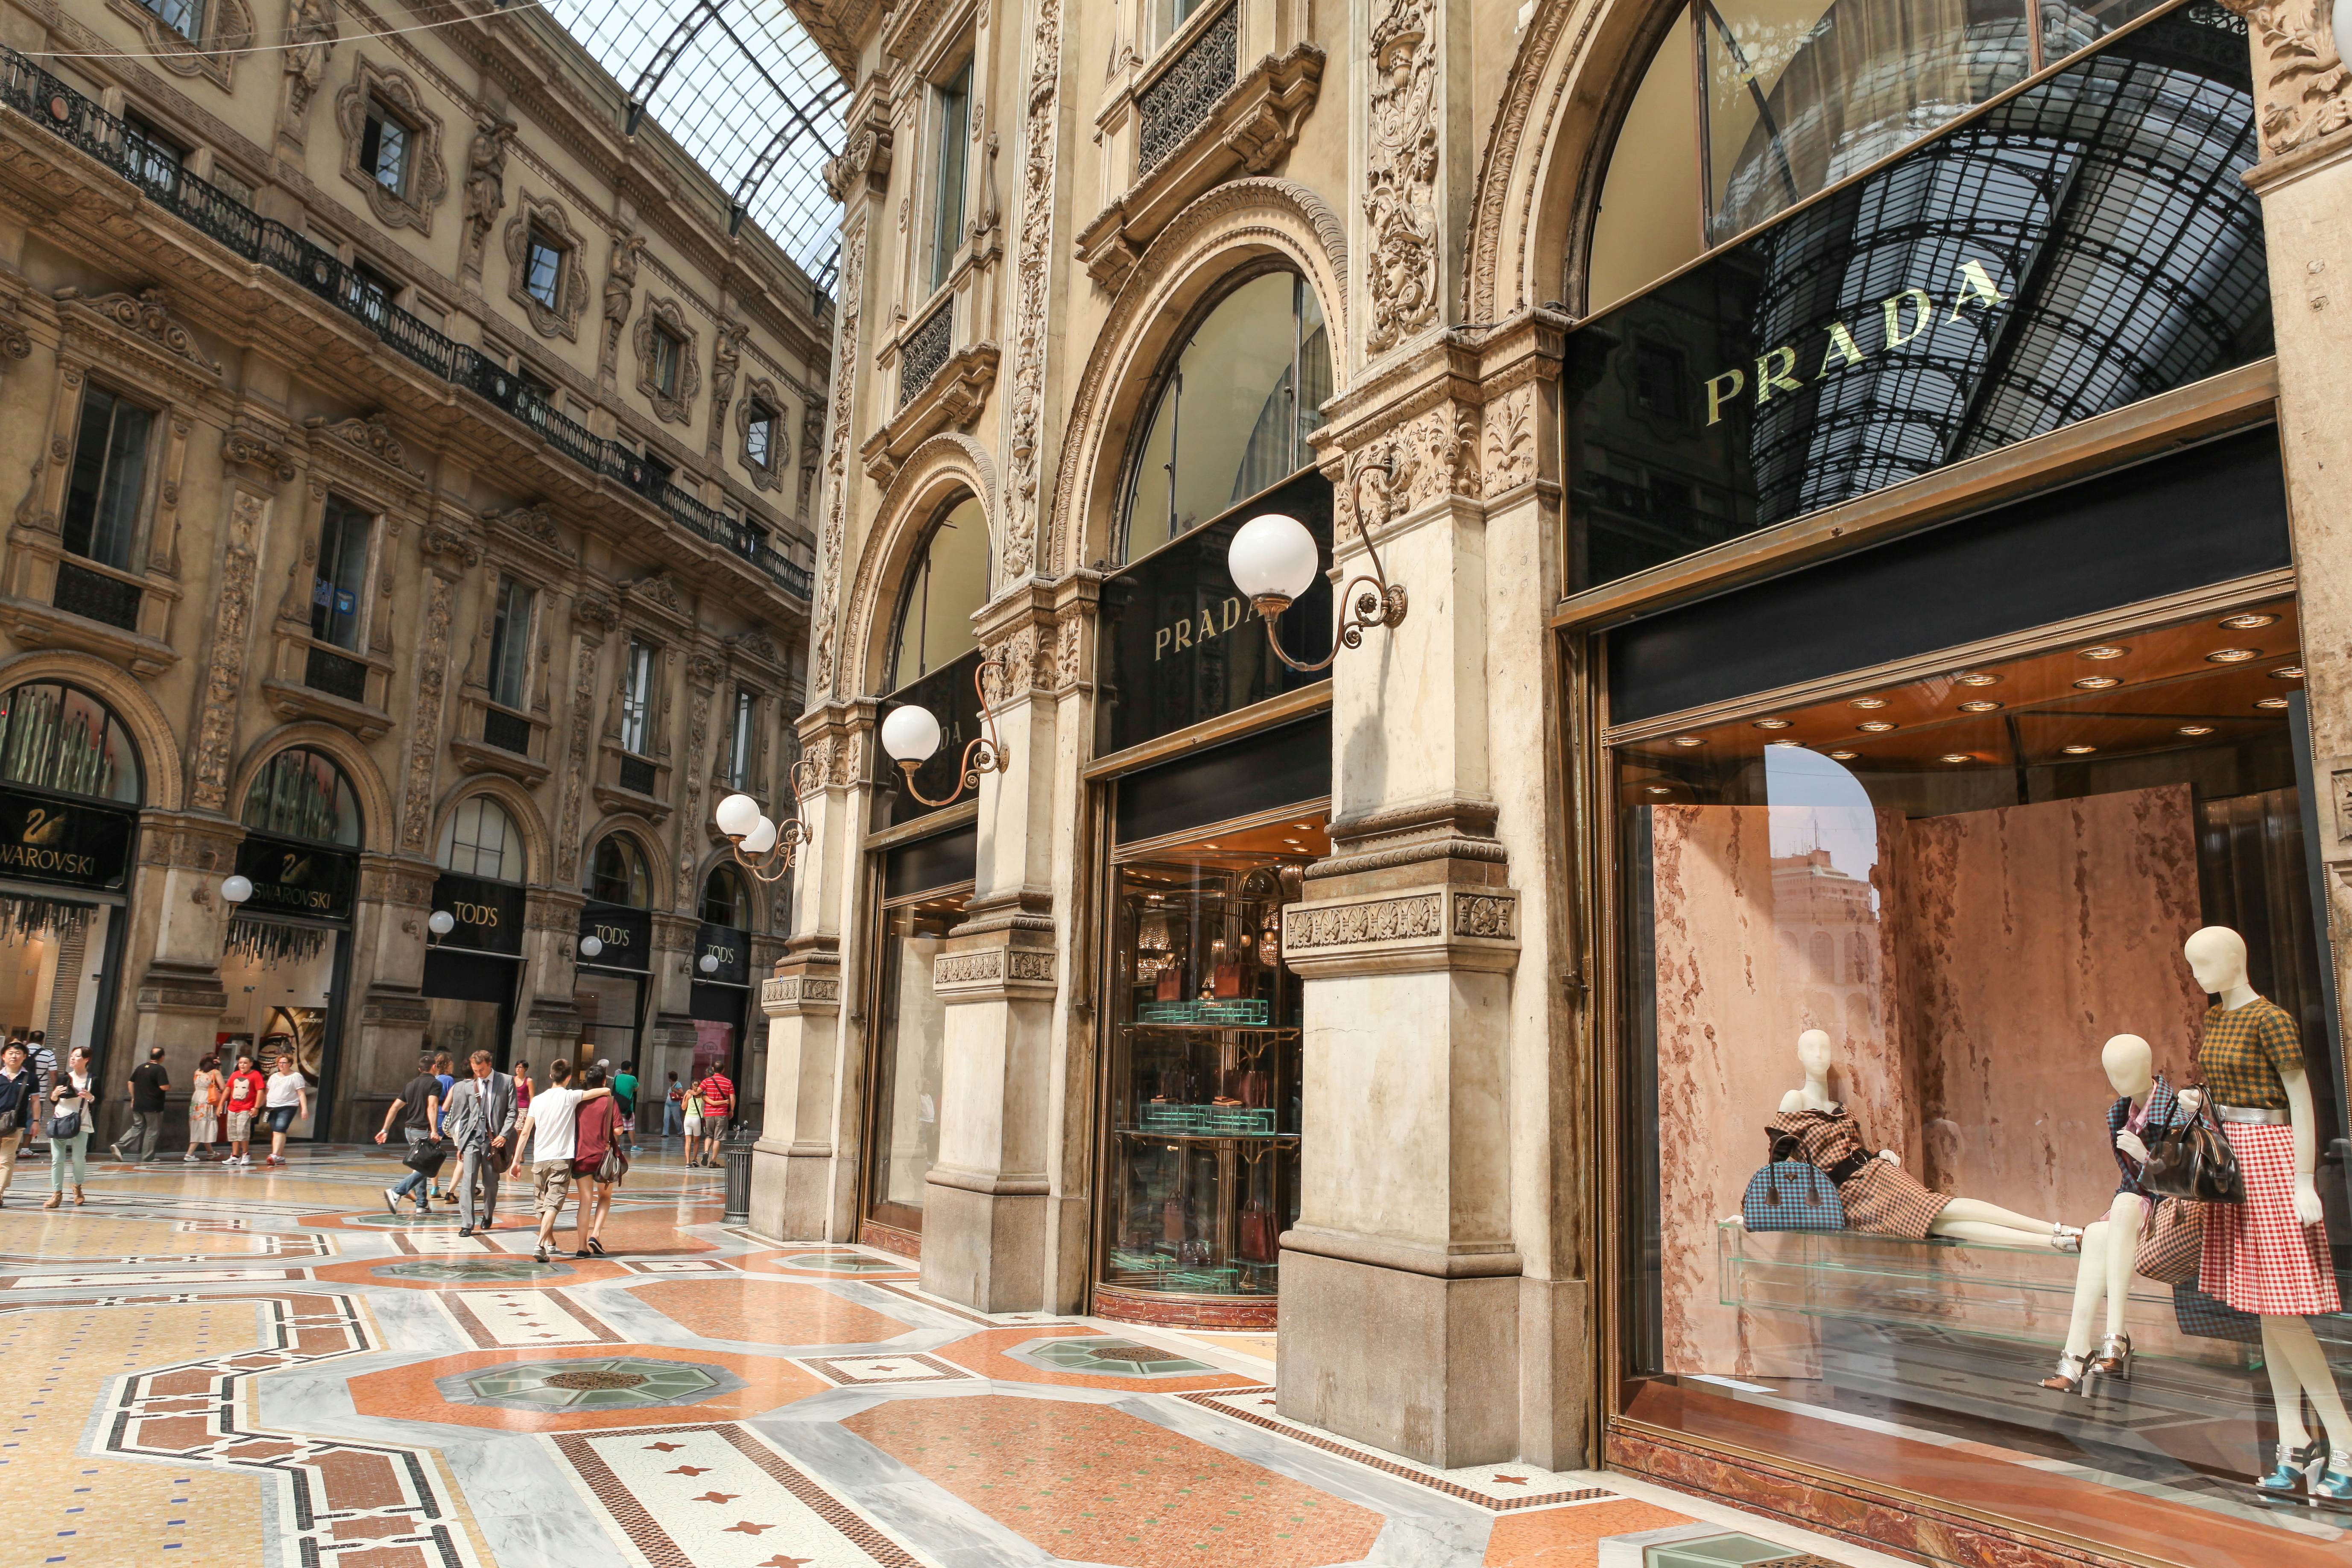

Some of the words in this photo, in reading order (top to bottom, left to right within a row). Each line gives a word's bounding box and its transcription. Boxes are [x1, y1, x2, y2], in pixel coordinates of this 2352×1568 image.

[1704, 259, 2010, 427] PRADA
[0, 844, 94, 875] WAROVSKI
[253, 882, 331, 909] SWAROVSKI
[454, 901, 497, 927] TOD'S
[595, 924, 629, 946] TOD'S
[707, 944, 734, 963] TOD'S
